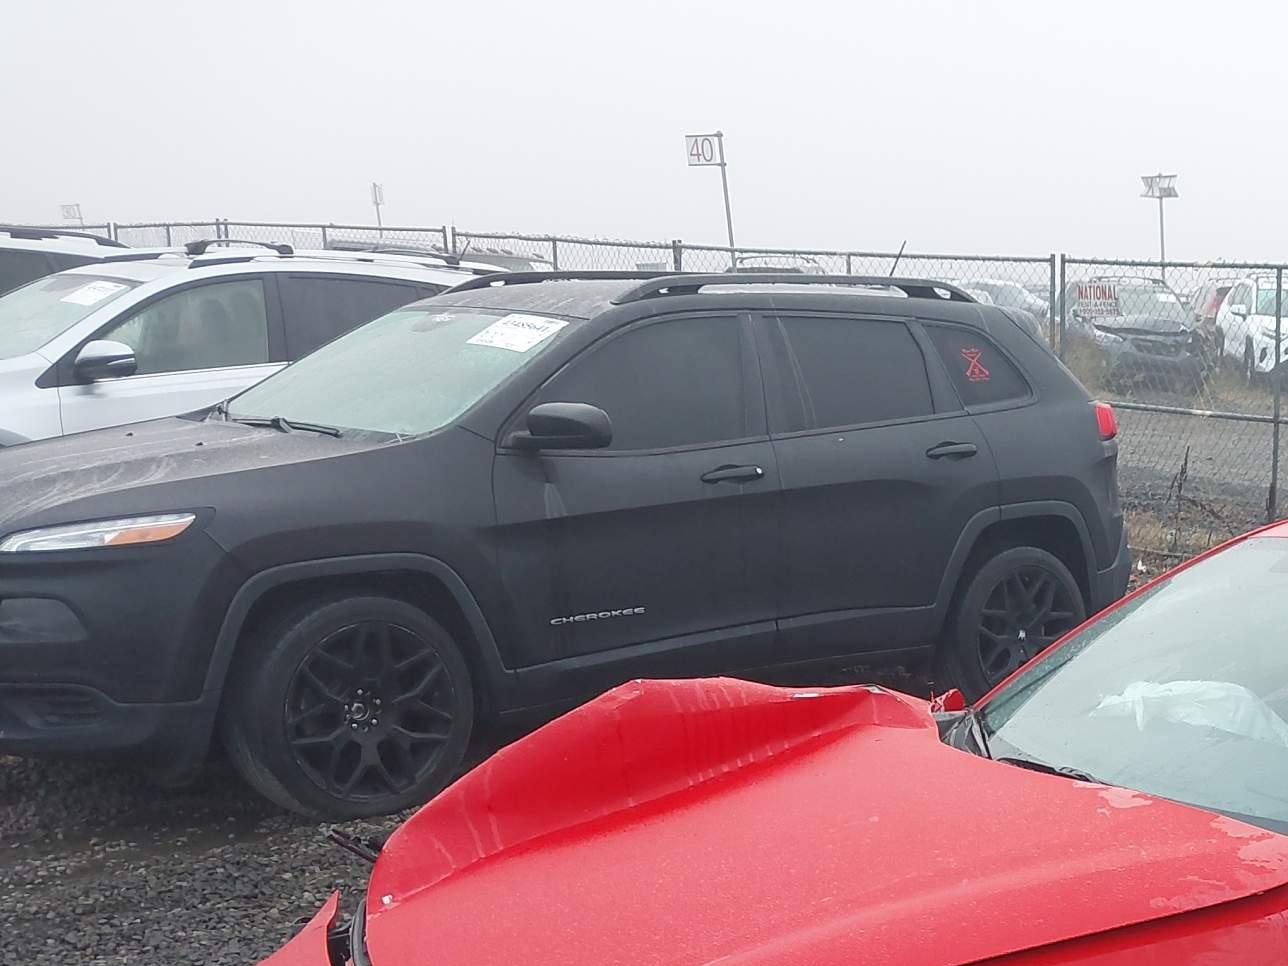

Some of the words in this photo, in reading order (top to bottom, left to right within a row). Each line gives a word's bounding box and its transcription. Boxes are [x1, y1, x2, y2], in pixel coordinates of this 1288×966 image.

[690, 138, 713, 162] 40
[1078, 284, 1119, 301] NATIONAL
[550, 607, 646, 625] CHEROKEE
